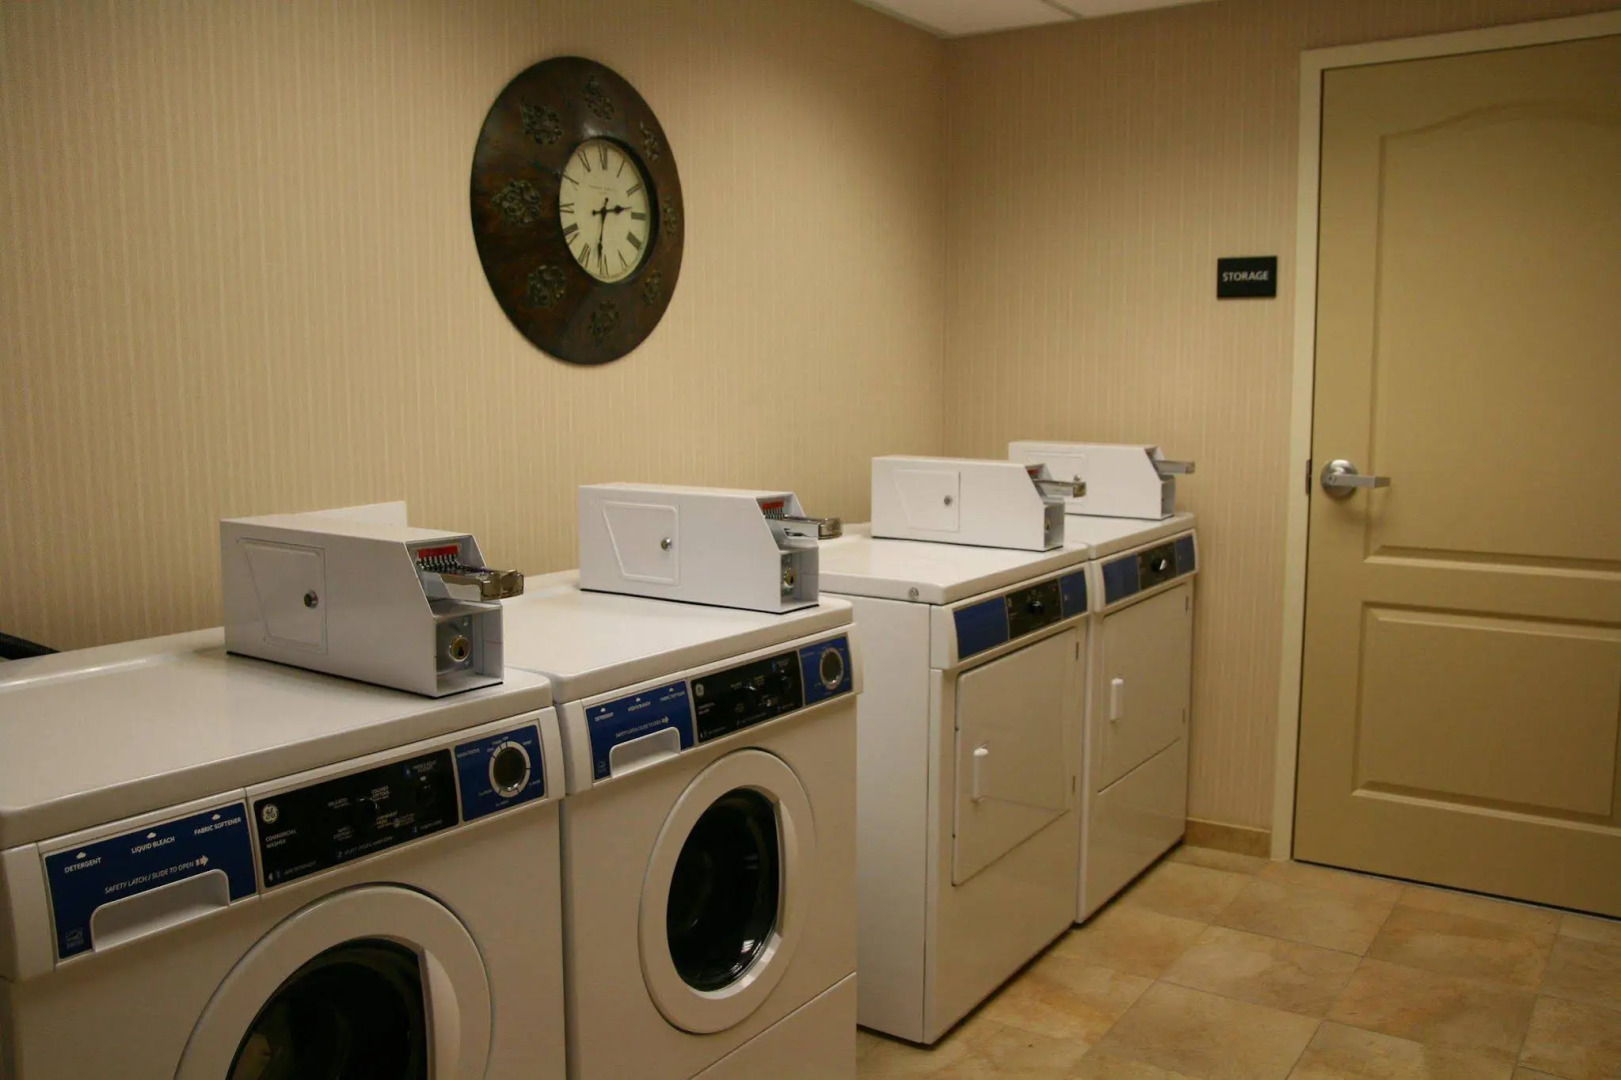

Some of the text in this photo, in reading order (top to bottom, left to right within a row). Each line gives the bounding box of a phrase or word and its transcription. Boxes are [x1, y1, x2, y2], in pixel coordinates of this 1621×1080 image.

[1222, 270, 1269, 282] STORAGE
[193, 816, 242, 836] FABRIC SOFTENER
[131, 836, 176, 854] LIQUID BLEACH
[64, 856, 102, 874] DETERGENT
[104, 882, 127, 894] SAFETY
[128, 875, 148, 887] LATCH
[152, 868, 169, 880] SLIDE
[169, 865, 178, 873] TO
[178, 860, 195, 872] OPEN
